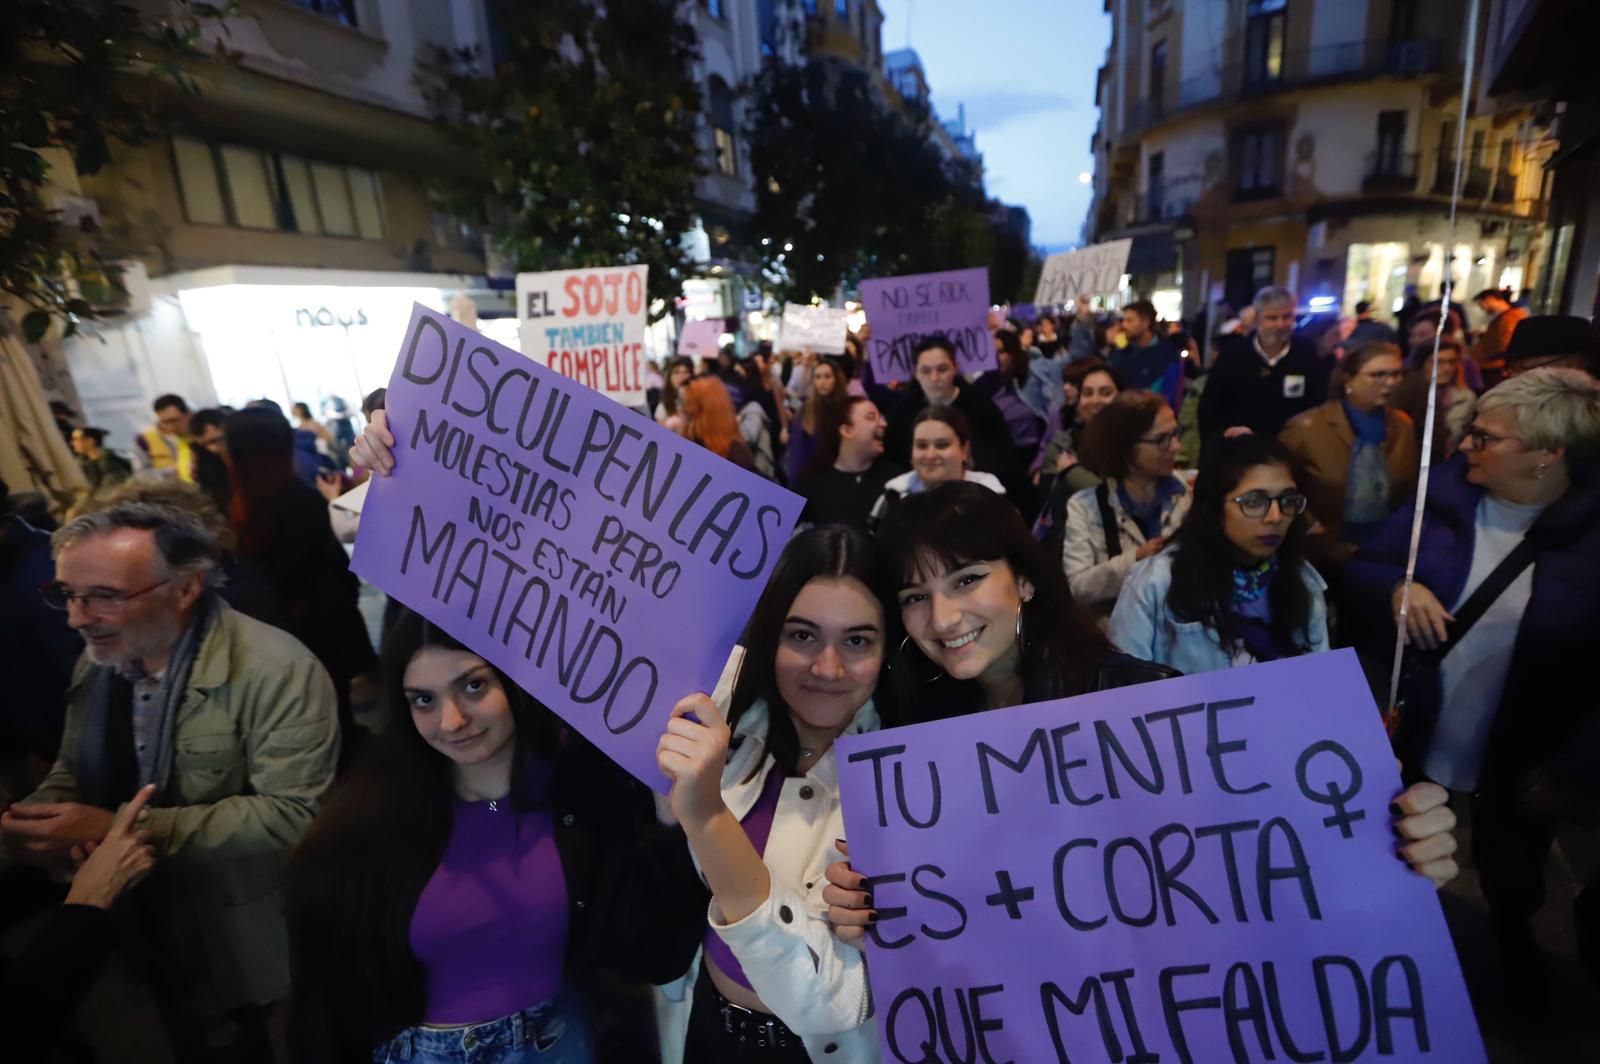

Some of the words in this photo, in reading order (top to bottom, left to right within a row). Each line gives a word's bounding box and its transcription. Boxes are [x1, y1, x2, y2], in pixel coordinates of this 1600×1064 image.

[527, 290, 555, 319] EL
[562, 271, 642, 318] SOJO
[881, 286, 909, 312] NO
[402, 315, 683, 522] DISCULPEN
[668, 474, 782, 580] LAS
[410, 410, 577, 532] MOLESTIAS
[592, 515, 682, 599] PERO
[467, 496, 526, 552] NOS
[400, 505, 659, 735] MATANDO
[847, 744, 942, 829] TU
[975, 696, 1273, 815] MENTE
[866, 864, 968, 950] ES
[1052, 817, 1323, 932] CORTA
[885, 984, 1016, 1064] QUE
[1040, 968, 1160, 1064] MI
[1158, 954, 1431, 1064] FALDA
